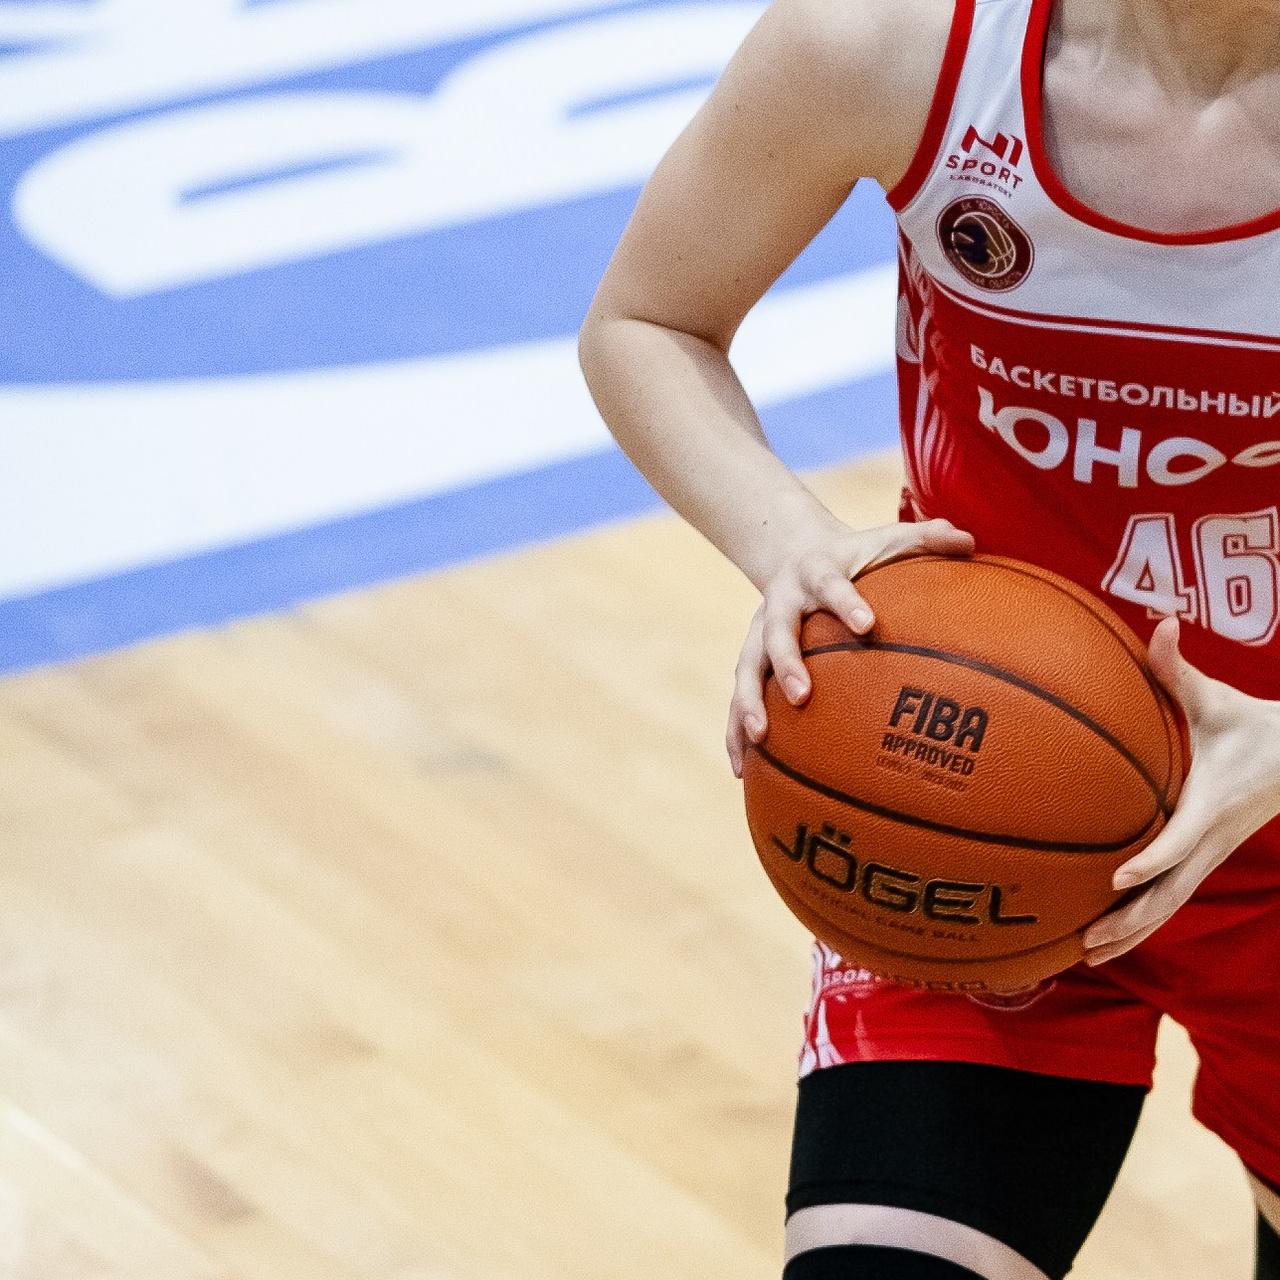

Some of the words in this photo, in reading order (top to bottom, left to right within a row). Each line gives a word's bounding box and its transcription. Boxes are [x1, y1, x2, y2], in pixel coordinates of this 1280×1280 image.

[946, 154, 1023, 190] SPORT
[887, 685, 989, 754] FIBA
[881, 732, 976, 776] APPROVED
[770, 822, 1039, 926] JÖGEL
